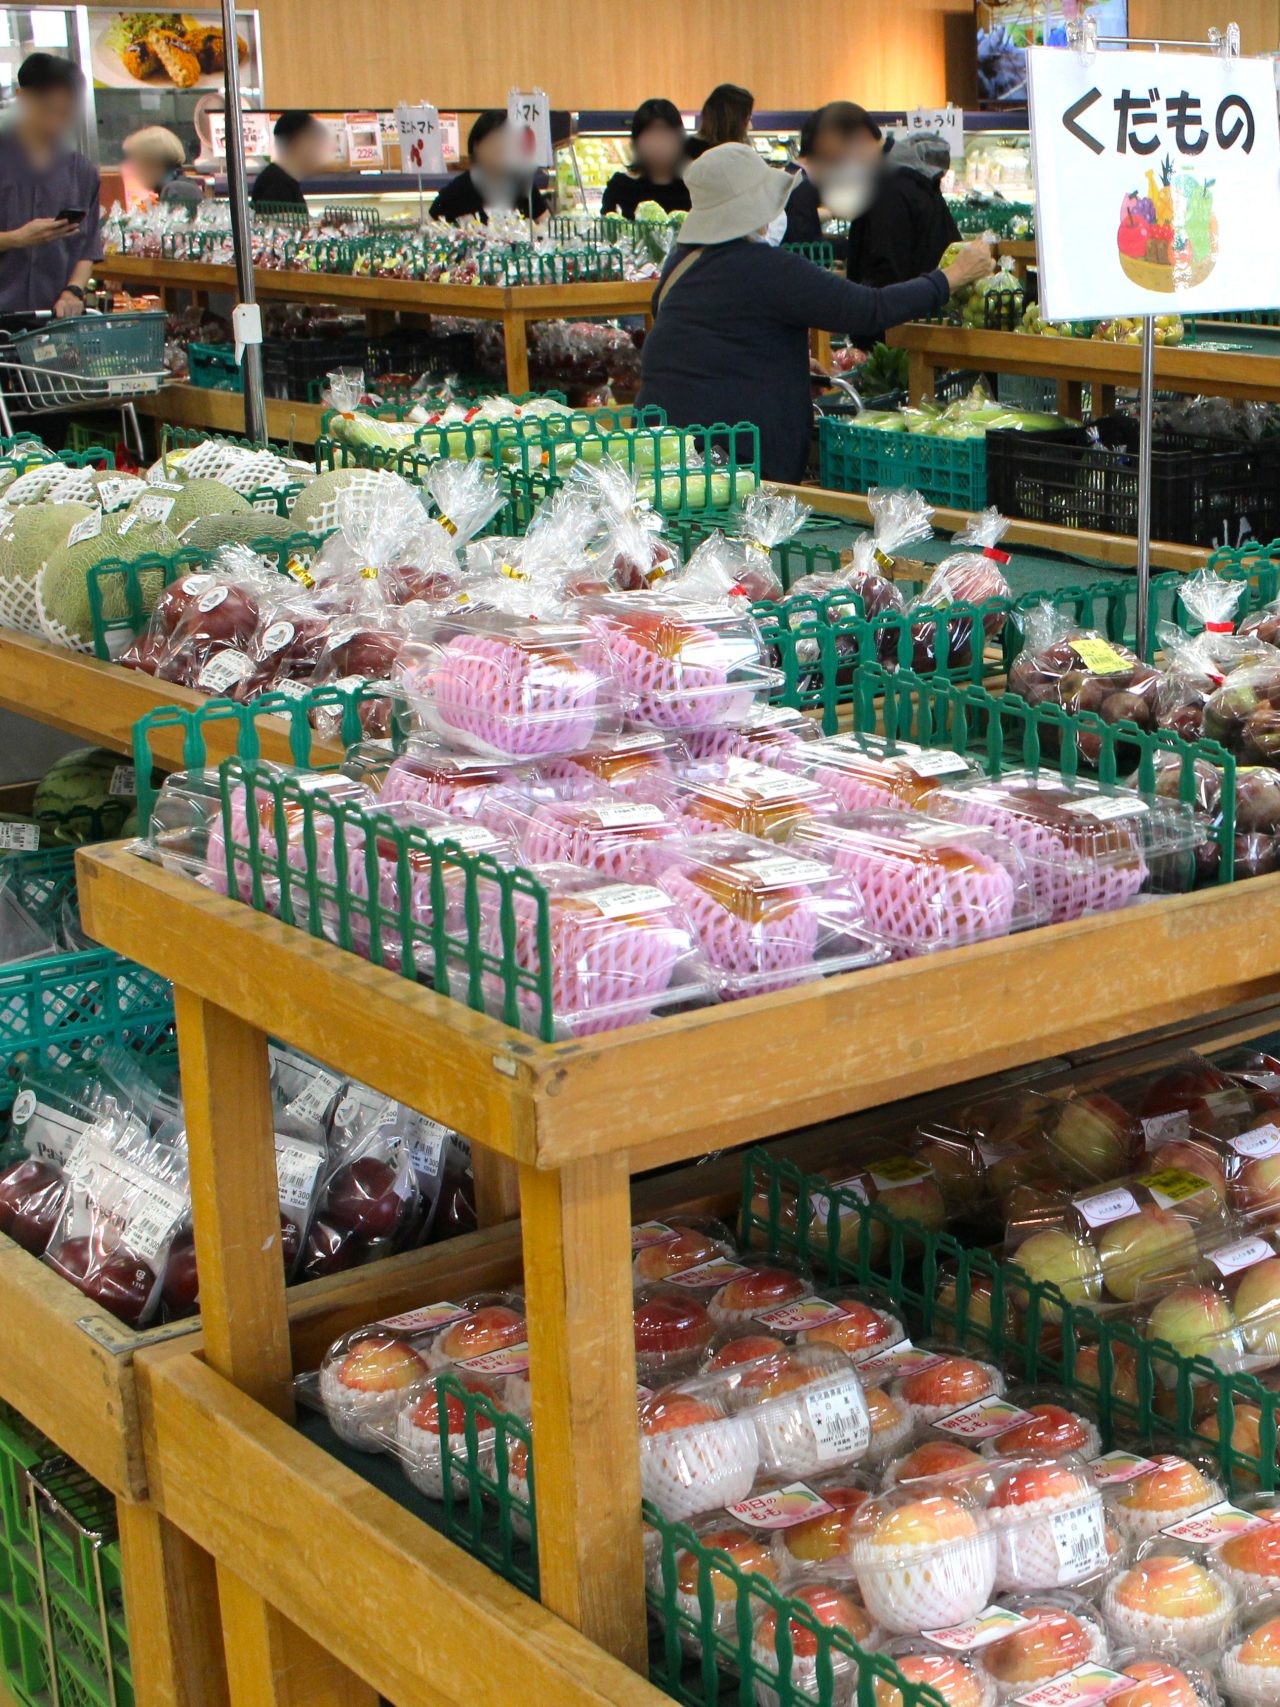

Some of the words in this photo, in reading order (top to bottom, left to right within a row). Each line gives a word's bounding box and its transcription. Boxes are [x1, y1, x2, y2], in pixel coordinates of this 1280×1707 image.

[515, 104, 540, 121] トマト
[401, 120, 434, 134] ミニトマト
[913, 115, 955, 128] きゅうり
[1062, 87, 1255, 156] くだもの
[762, 1308, 799, 1323] 朝日の
[779, 1314, 806, 1327] もも
[942, 1412, 980, 1429] 朝日の
[960, 1421, 988, 1434] もも
[733, 1497, 777, 1514] 朝日の
[751, 1509, 782, 1521] もも
[1172, 1518, 1213, 1536] 朝日の
[1192, 1527, 1222, 1539] もも
[1025, 1682, 1071, 1703] 朝日の
[1047, 1692, 1080, 1706] もも
